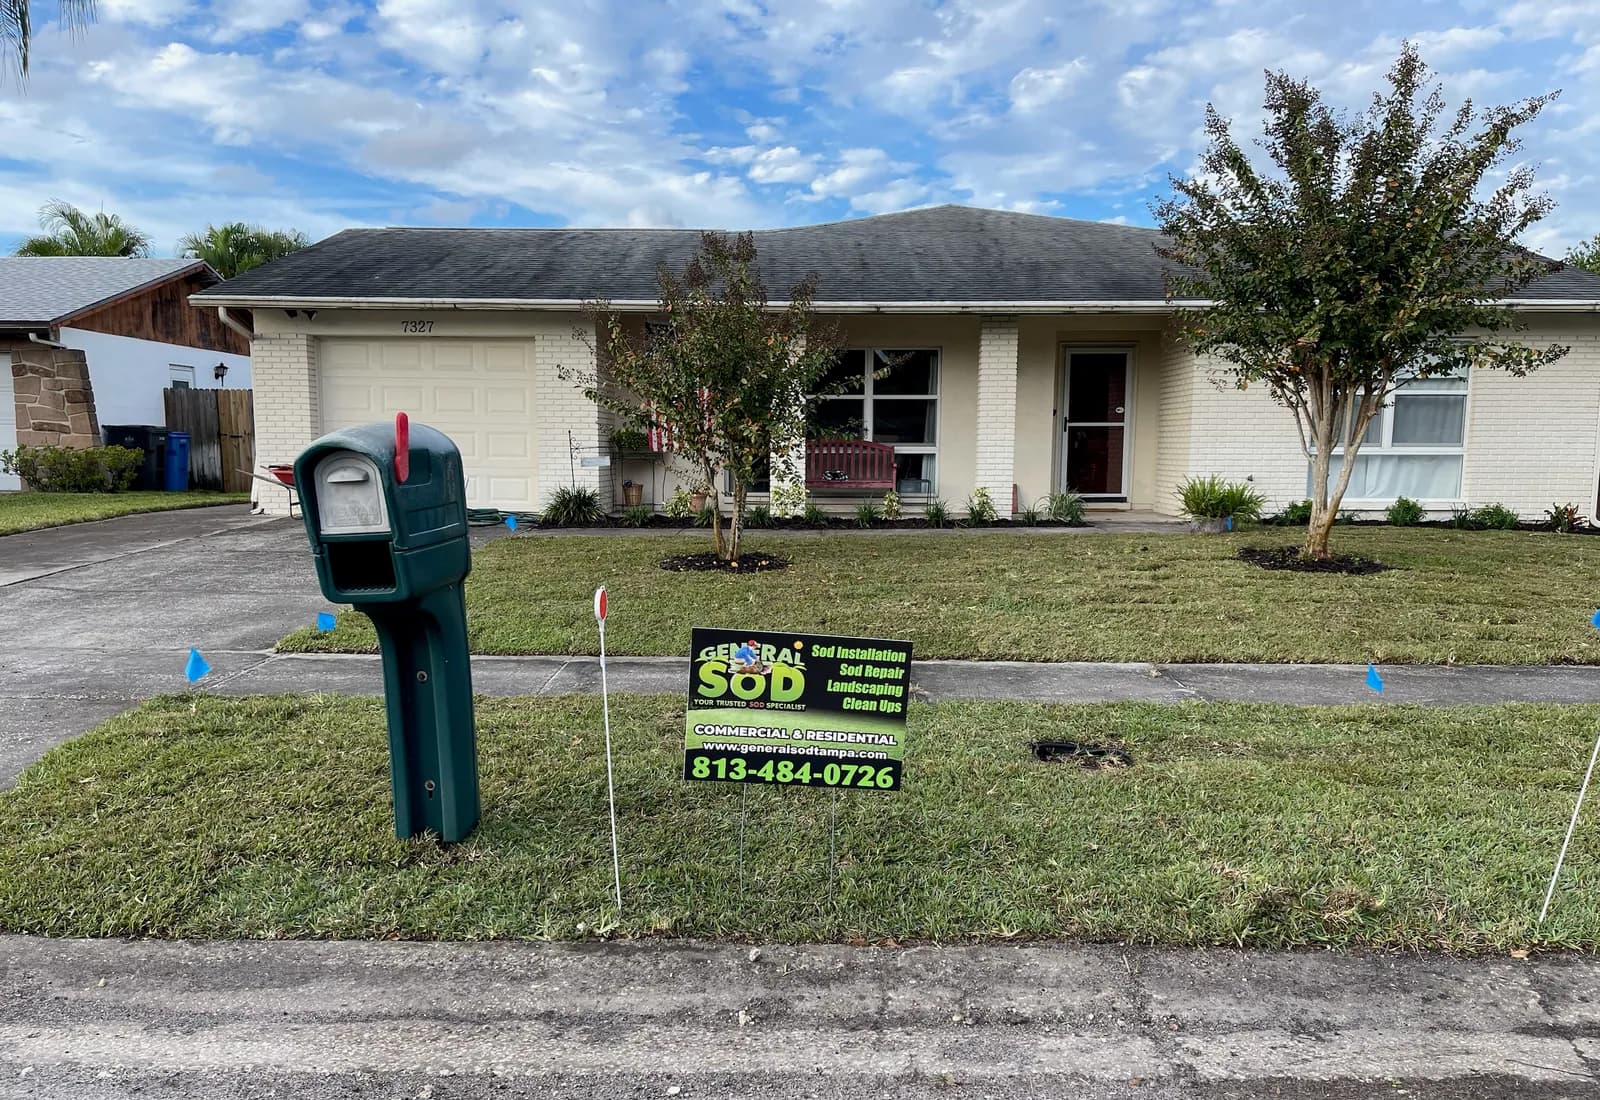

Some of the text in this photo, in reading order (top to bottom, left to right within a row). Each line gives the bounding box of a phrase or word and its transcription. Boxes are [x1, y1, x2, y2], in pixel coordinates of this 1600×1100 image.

[401, 320, 434, 333] 7327
[699, 642, 805, 665] GENRAL
[811, 644, 907, 663] Sod Installation
[839, 663, 905, 679] Sod Repair
[697, 660, 806, 702] SOD
[826, 679, 904, 698] Landscaping
[694, 698, 714, 706] YOUR
[716, 700, 747, 708] TRUSTED
[766, 702, 807, 711] SPECIALIST
[842, 697, 902, 713] Clean Ups
[694, 724, 898, 745] COMMERCIAL & RESIDENTIAL
[703, 742, 888, 760] www.generalsodtampa.com
[692, 756, 895, 788] 813-484-0726
